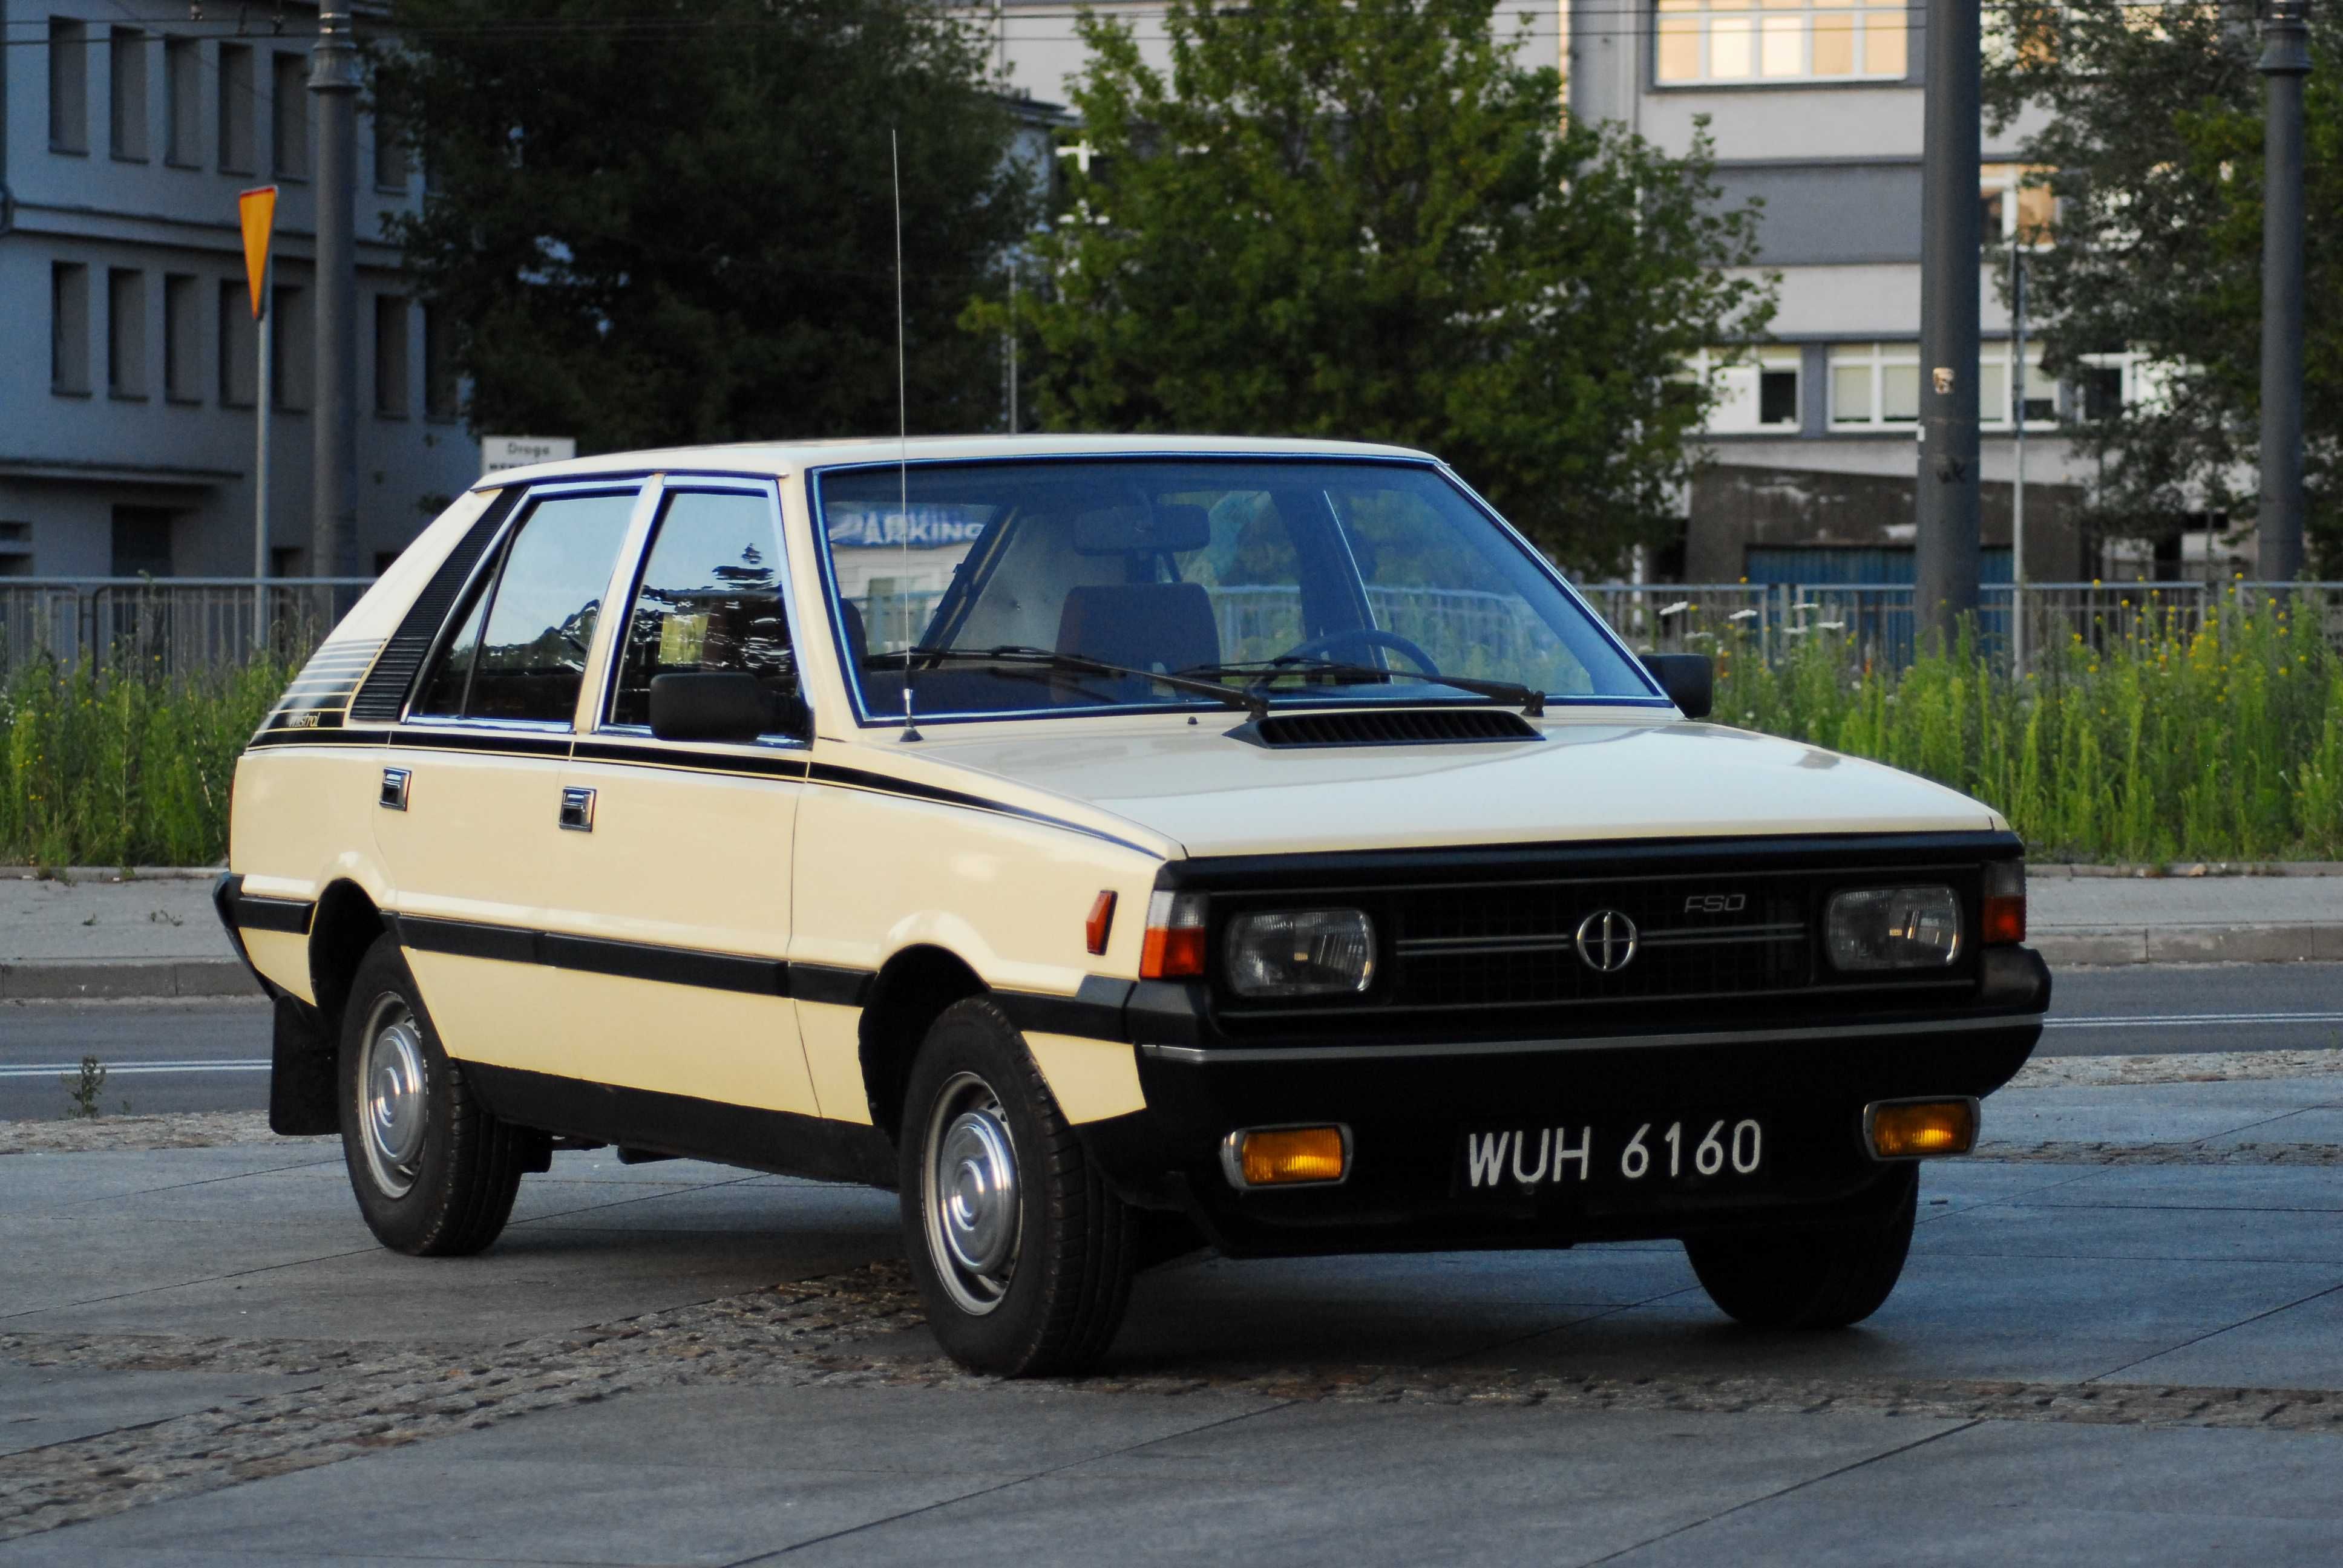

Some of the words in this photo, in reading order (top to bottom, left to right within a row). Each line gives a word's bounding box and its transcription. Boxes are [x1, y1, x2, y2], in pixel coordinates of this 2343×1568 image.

[1685, 893, 1746, 913] FSO
[1469, 1126, 1591, 1187] WUH
[1621, 1119, 1761, 1178] 6160
